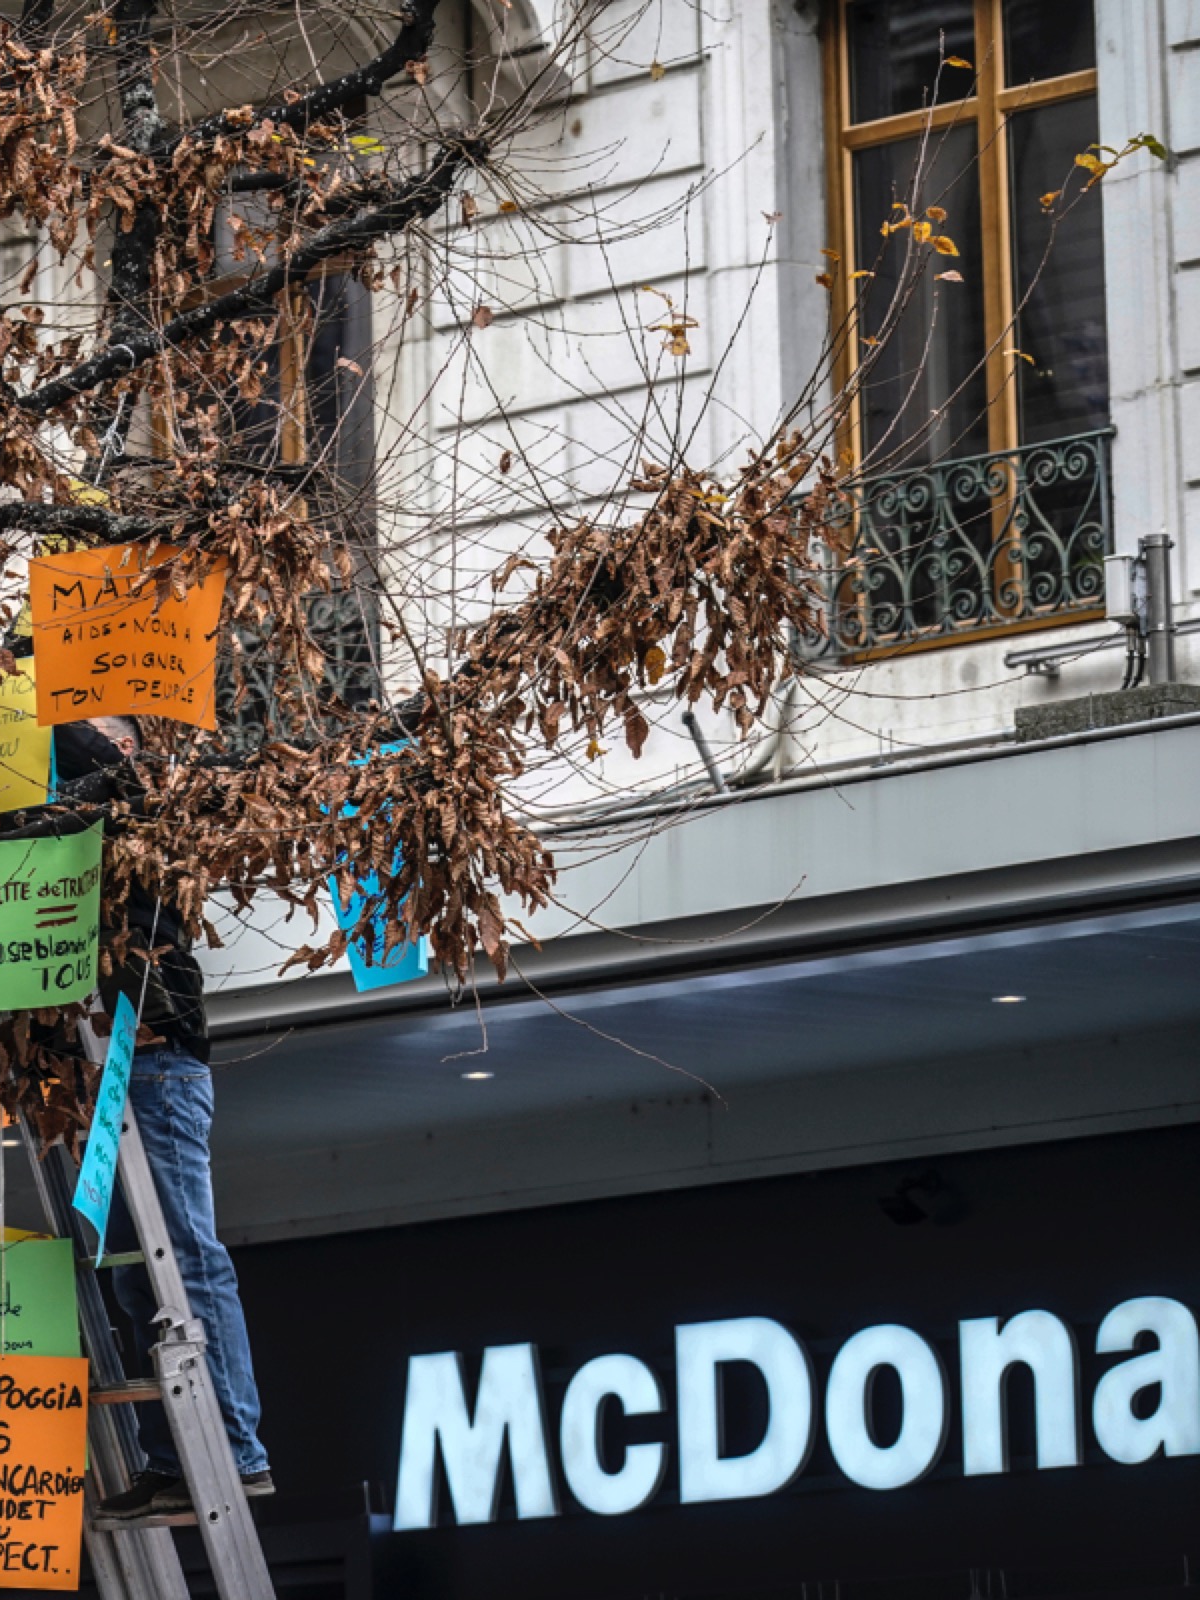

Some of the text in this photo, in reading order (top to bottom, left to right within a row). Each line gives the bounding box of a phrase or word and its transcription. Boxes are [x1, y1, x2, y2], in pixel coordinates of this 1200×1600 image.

[91, 651, 186, 675] SOIGNER
[50, 679, 195, 712] TON PEUPLE
[32, 955, 91, 991] TOUS
[393, 1295, 1200, 1532] McDona
